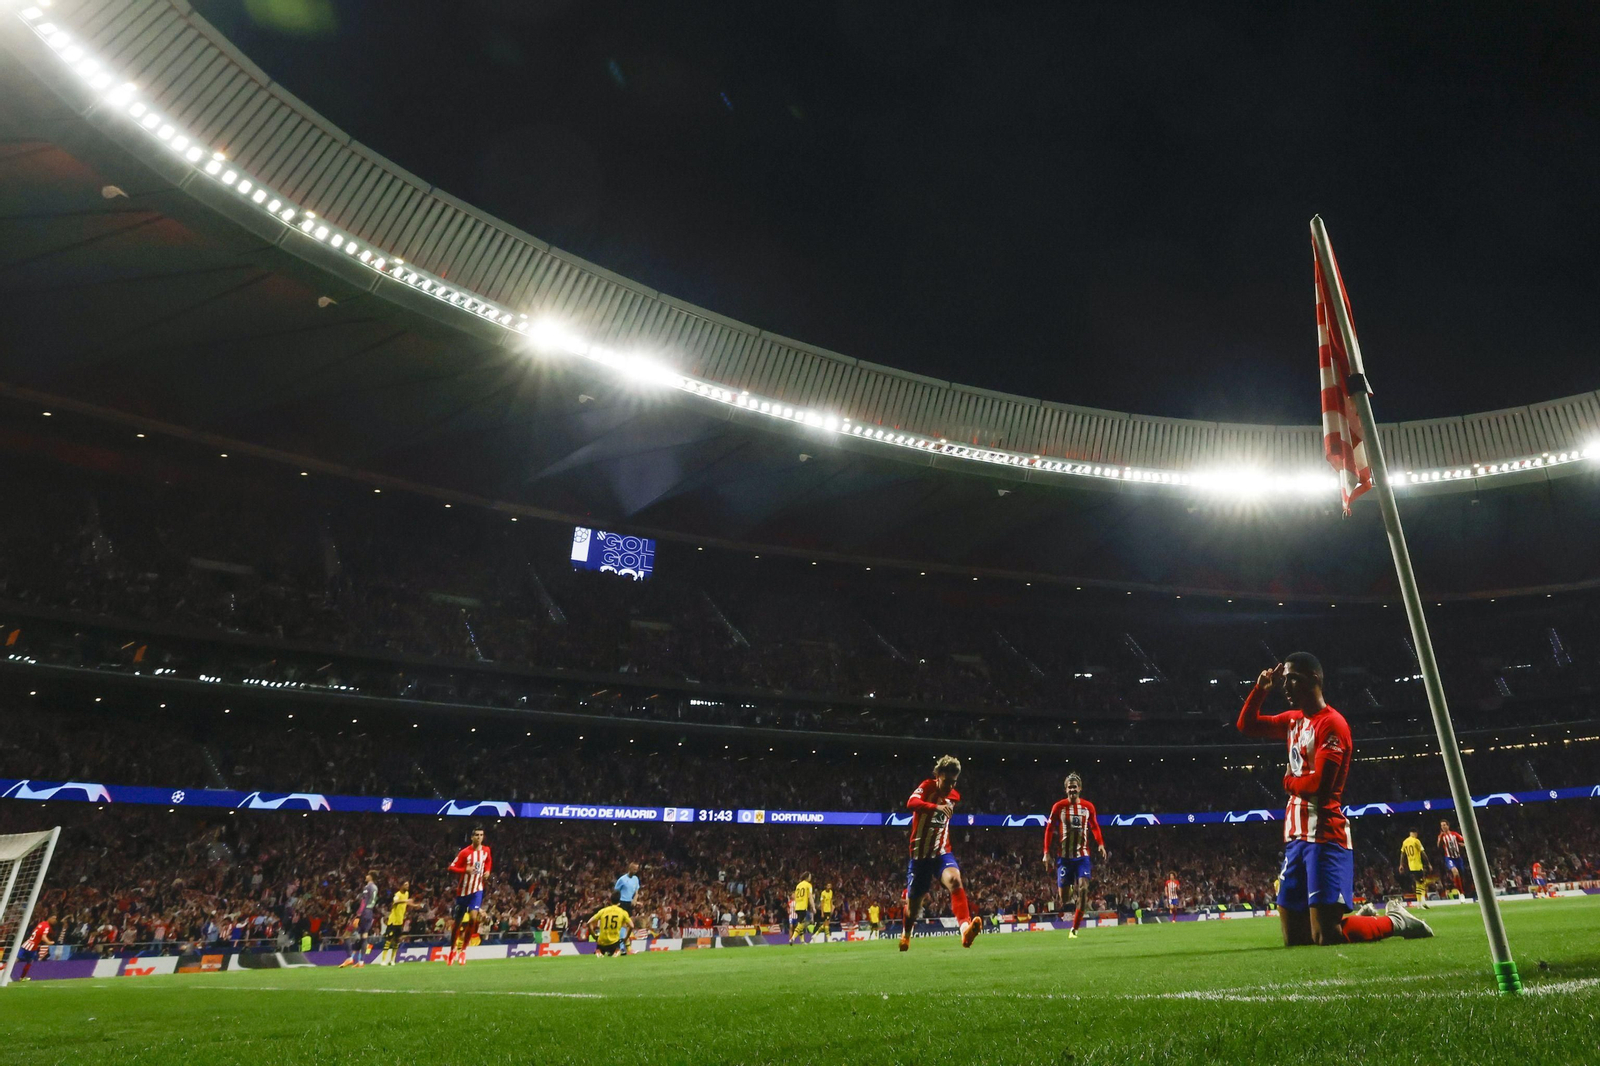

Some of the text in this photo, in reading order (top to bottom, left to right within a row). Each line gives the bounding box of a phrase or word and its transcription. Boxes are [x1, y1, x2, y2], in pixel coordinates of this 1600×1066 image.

[602, 533, 655, 556] GOL
[601, 549, 653, 572] GOL
[540, 805, 657, 819] ATLÉTICO DE MADRID
[680, 810, 689, 820] 2
[699, 809, 733, 821] 31:43
[742, 812, 752, 821] 0
[771, 813, 824, 822] DORTMUND
[796, 887, 806, 898] 20
[603, 914, 619, 930] 15
[914, 930, 960, 938] CHAMPIONS
